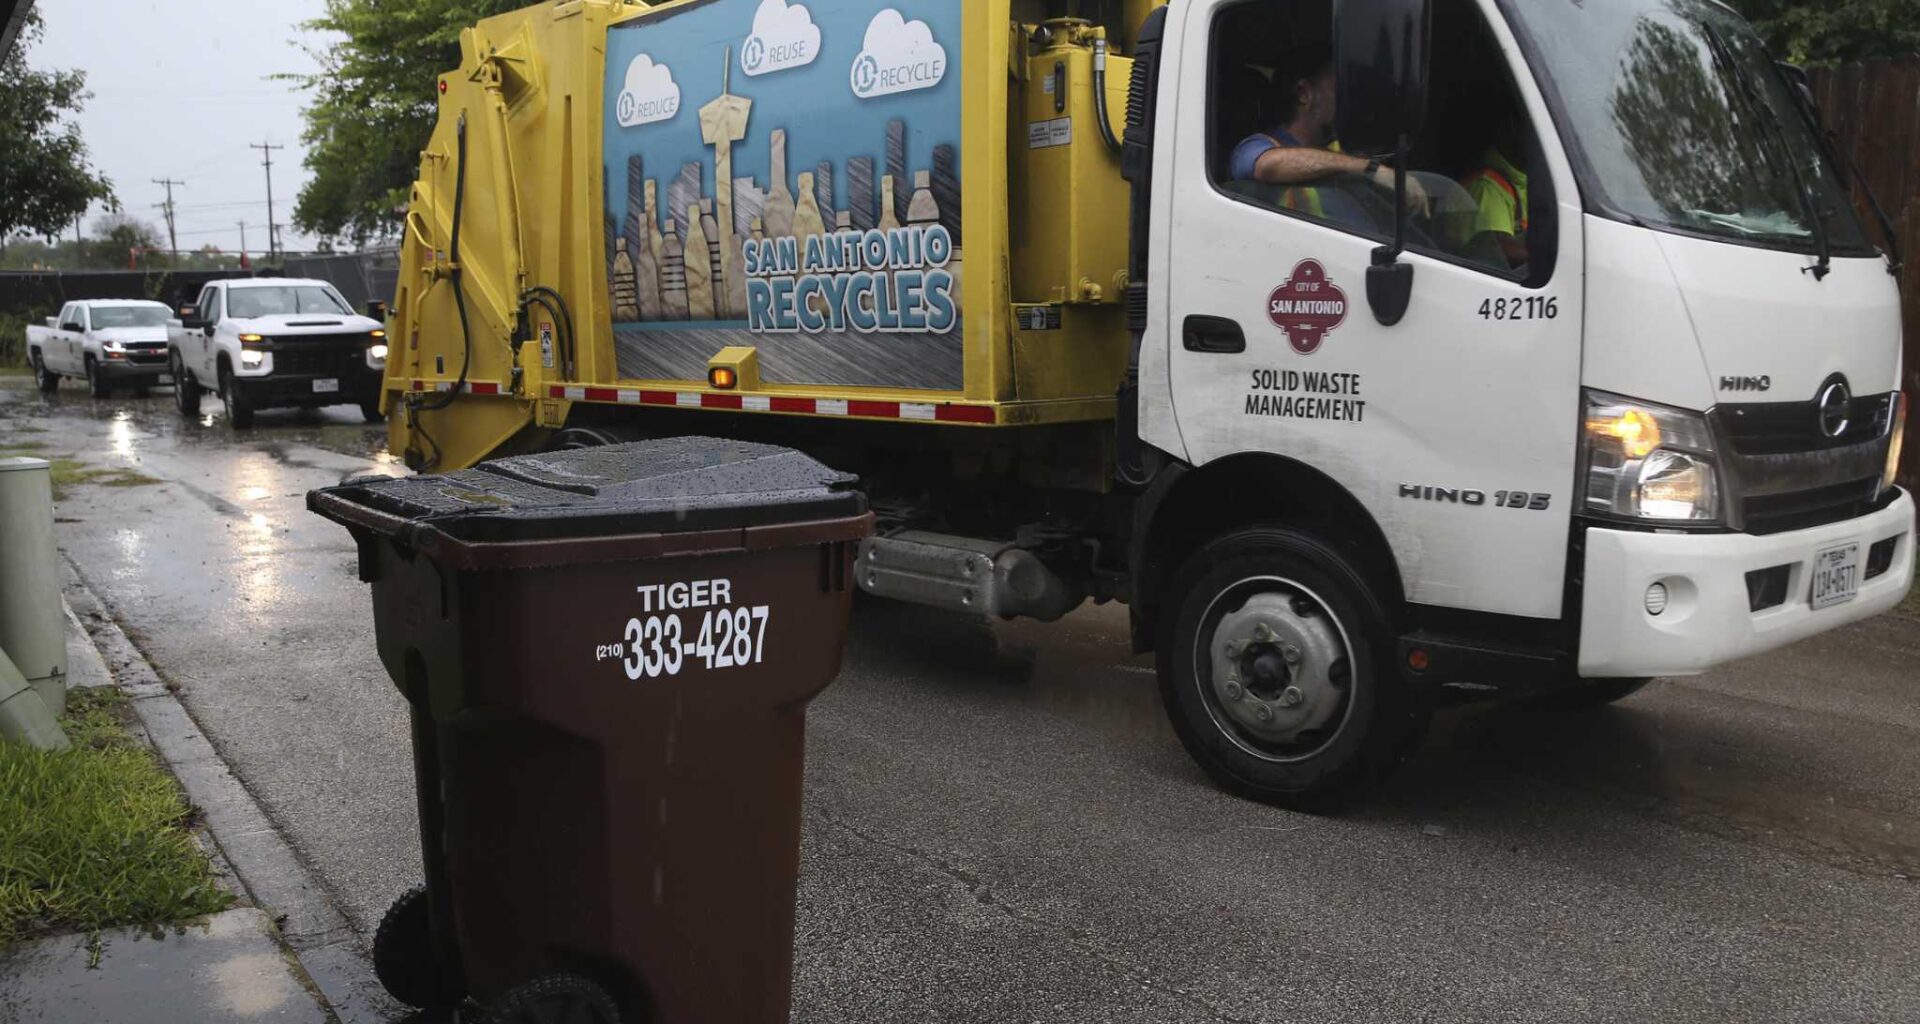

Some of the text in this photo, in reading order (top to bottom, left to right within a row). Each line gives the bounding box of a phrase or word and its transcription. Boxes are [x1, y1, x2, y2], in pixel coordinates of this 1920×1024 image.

[769, 40, 806, 64] REUSE
[880, 60, 941, 89] RECYCLE
[637, 96, 676, 118] REDUCE
[743, 224, 951, 276] SAN ANTONIO
[1295, 282, 1320, 292] CITY OF
[746, 268, 956, 334] RECYCLES
[1271, 300, 1344, 315] SAN ANTONIO
[1478, 296, 1558, 320] 482116
[1251, 369, 1361, 395] SOLID WASTE
[1719, 375, 1771, 391] HINO
[1245, 394, 1366, 422] MANAGEMENT
[1398, 482, 1552, 511] HINO 195
[636, 578, 732, 612] TIGER
[596, 605, 769, 680] (210) 333-4287
